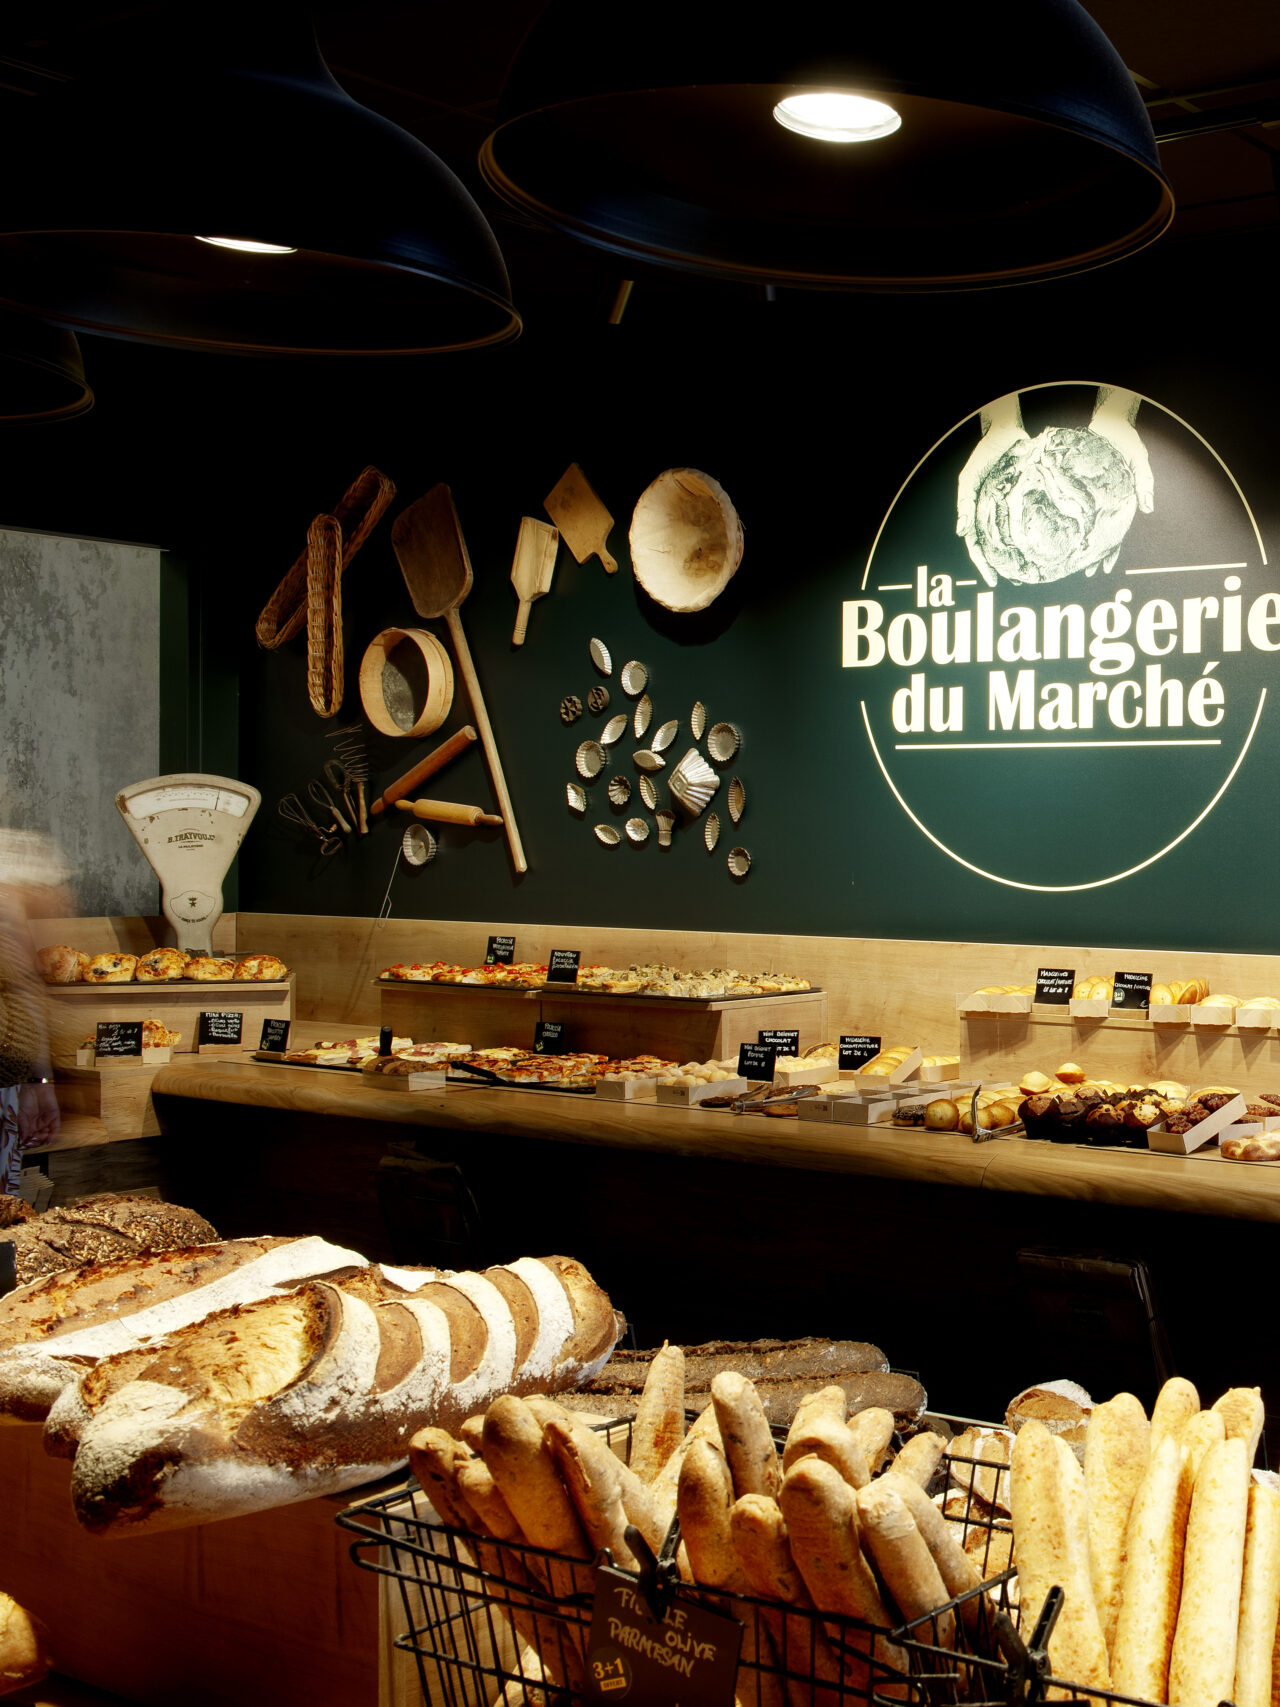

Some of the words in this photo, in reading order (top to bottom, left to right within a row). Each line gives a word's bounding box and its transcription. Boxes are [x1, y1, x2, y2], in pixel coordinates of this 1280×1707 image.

[917, 565, 955, 608] la
[892, 672, 963, 733] du
[989, 661, 1225, 731] Marché
[592, 1657, 625, 1680] 3+1
[608, 1617, 695, 1678] PARMESAN
